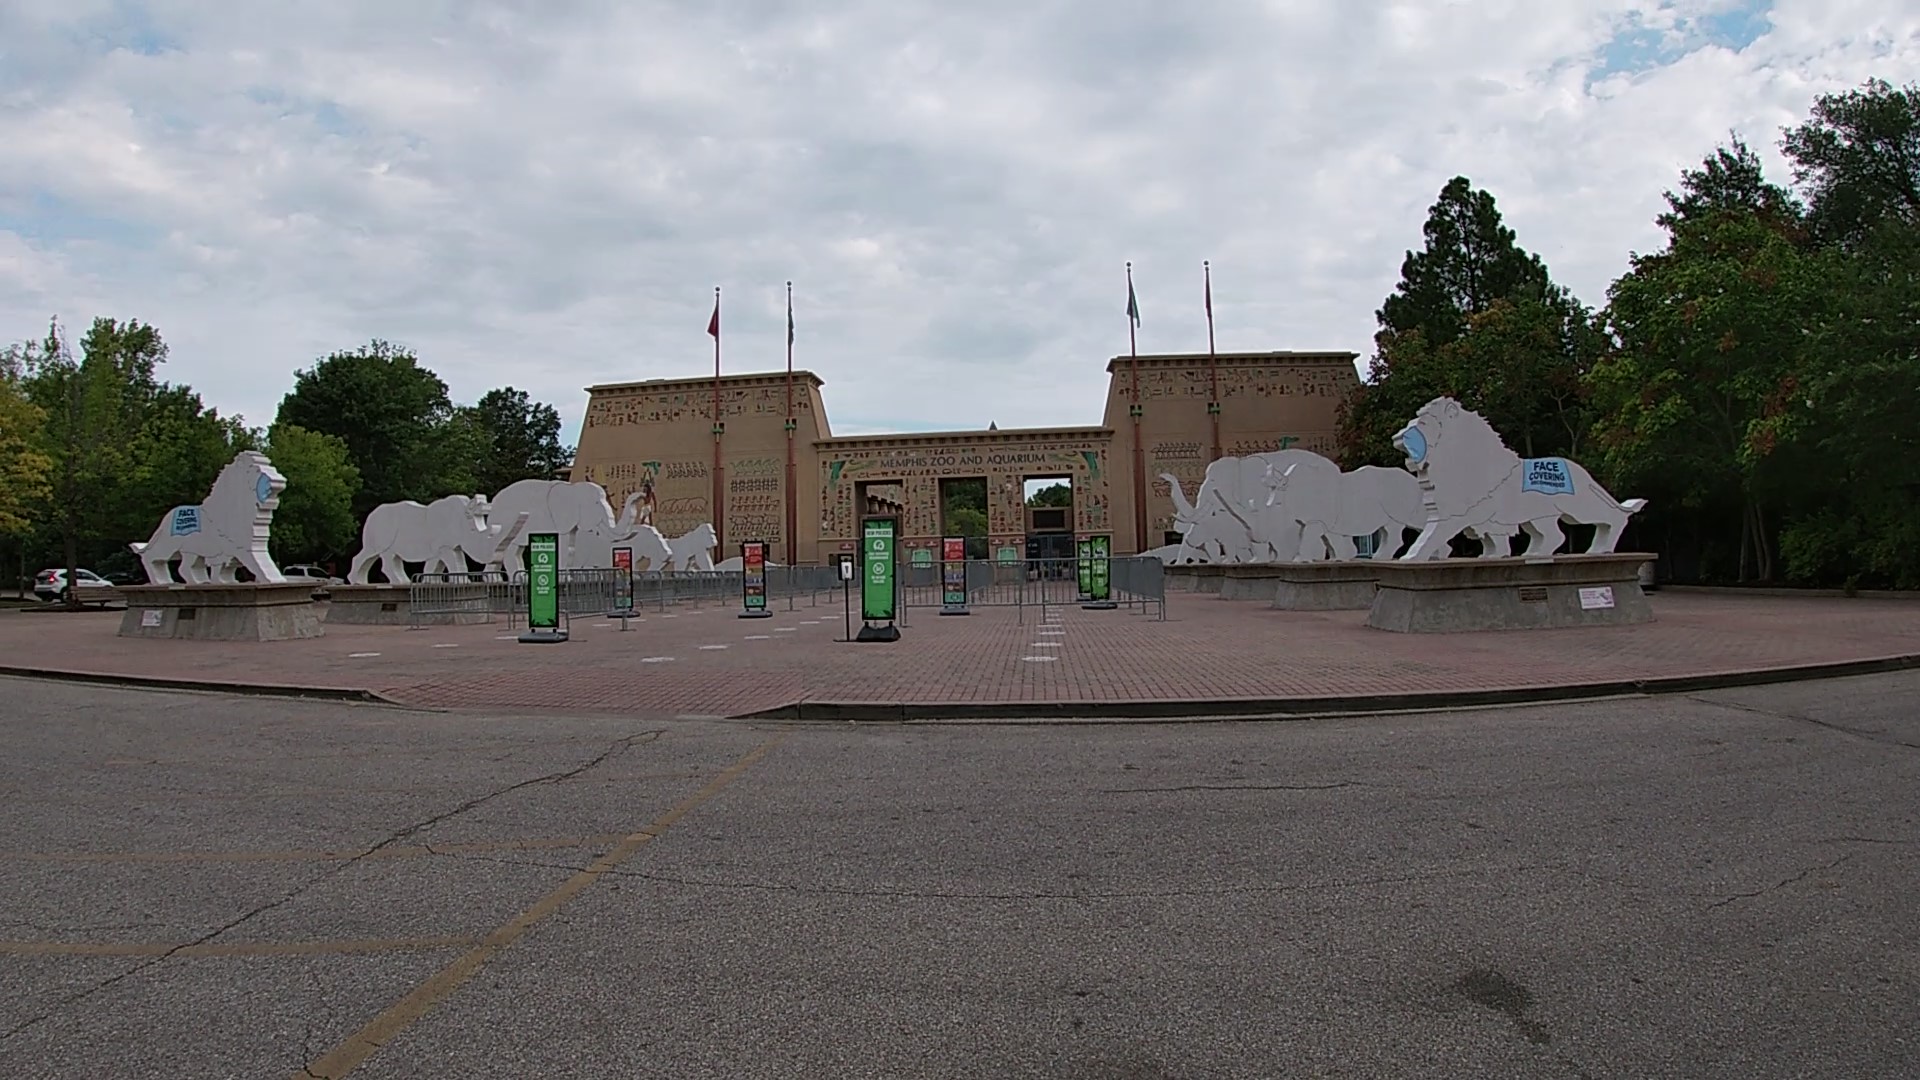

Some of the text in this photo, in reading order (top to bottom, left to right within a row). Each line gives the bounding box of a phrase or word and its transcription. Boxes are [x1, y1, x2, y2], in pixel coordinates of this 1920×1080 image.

[880, 454, 1046, 468] MEMPHIS ZOO AND AQUARIUM
[1533, 461, 1559, 472] FACE
[1529, 472, 1565, 481] COVERING
[178, 509, 195, 517] FACE
